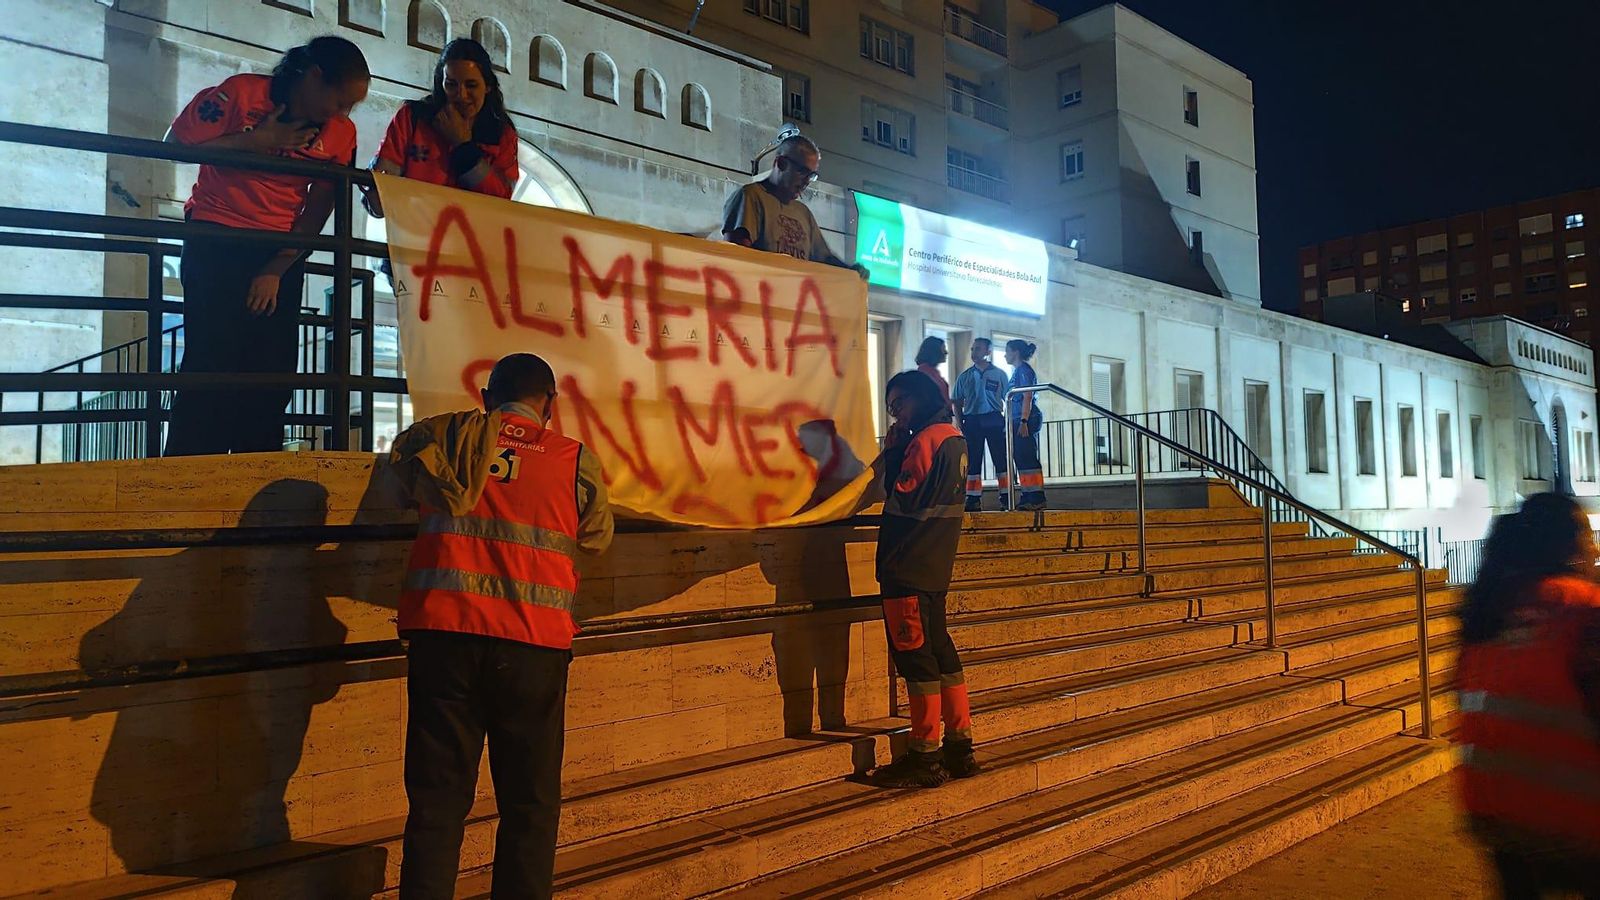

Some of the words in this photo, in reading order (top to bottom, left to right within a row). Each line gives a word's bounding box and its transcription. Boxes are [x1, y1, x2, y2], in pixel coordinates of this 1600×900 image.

[907, 261, 932, 273] Hospital
[908, 247, 932, 260] Centro
[933, 252, 963, 268] Periférico
[964, 260, 972, 269] de
[973, 262, 1016, 279] Especialidades
[1016, 271, 1030, 281] Bola
[1030, 274, 1042, 284] Azul
[412, 204, 844, 378] ALMERIA
[499, 439, 546, 453] SANITARIAS
